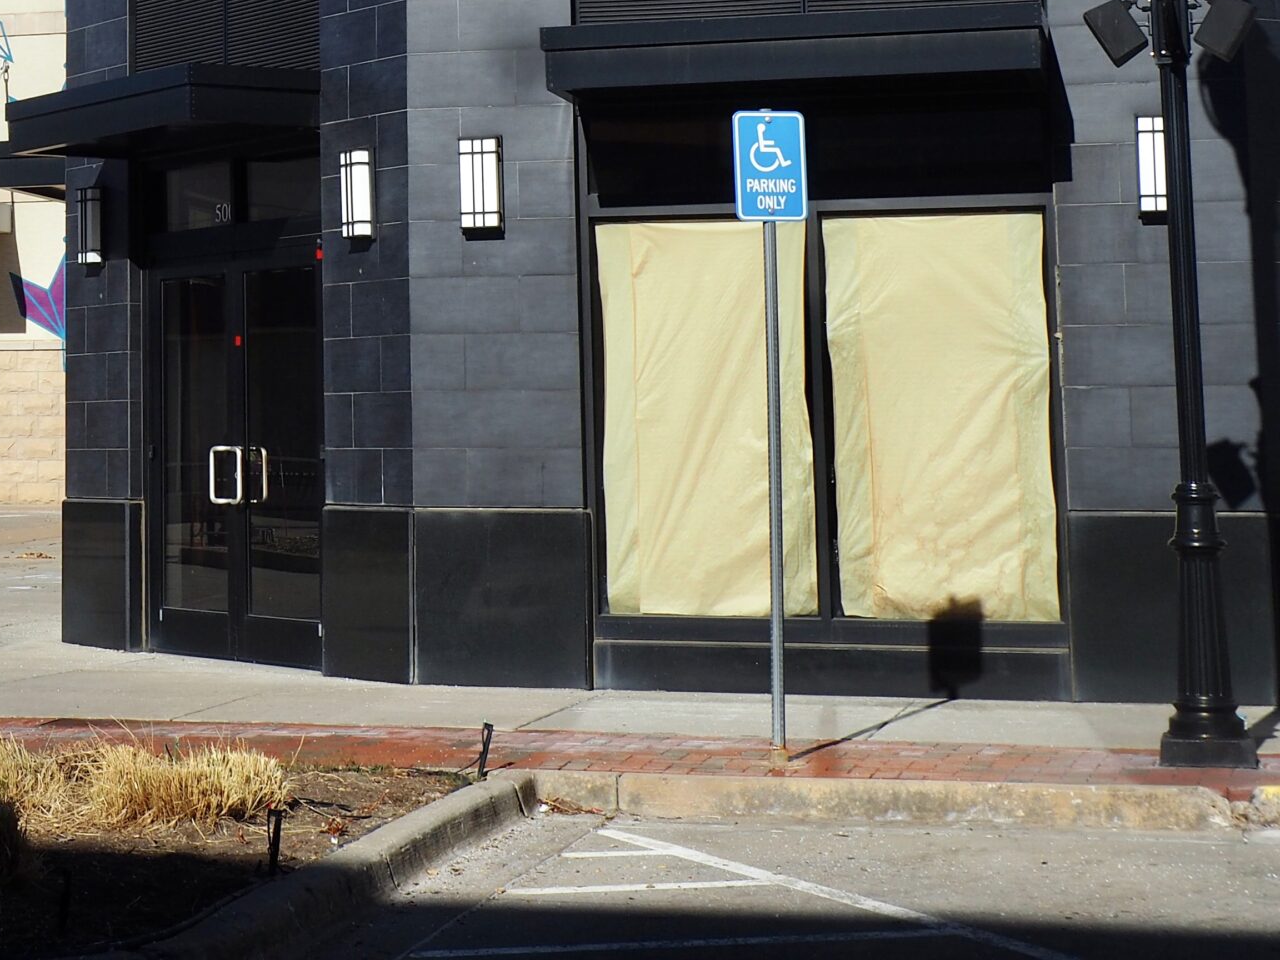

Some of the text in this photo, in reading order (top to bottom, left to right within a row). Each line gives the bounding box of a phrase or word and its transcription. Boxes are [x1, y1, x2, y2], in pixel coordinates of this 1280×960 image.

[746, 178, 797, 193] PARKING
[757, 195, 787, 210] ONLY
[215, 203, 231, 222] 50
